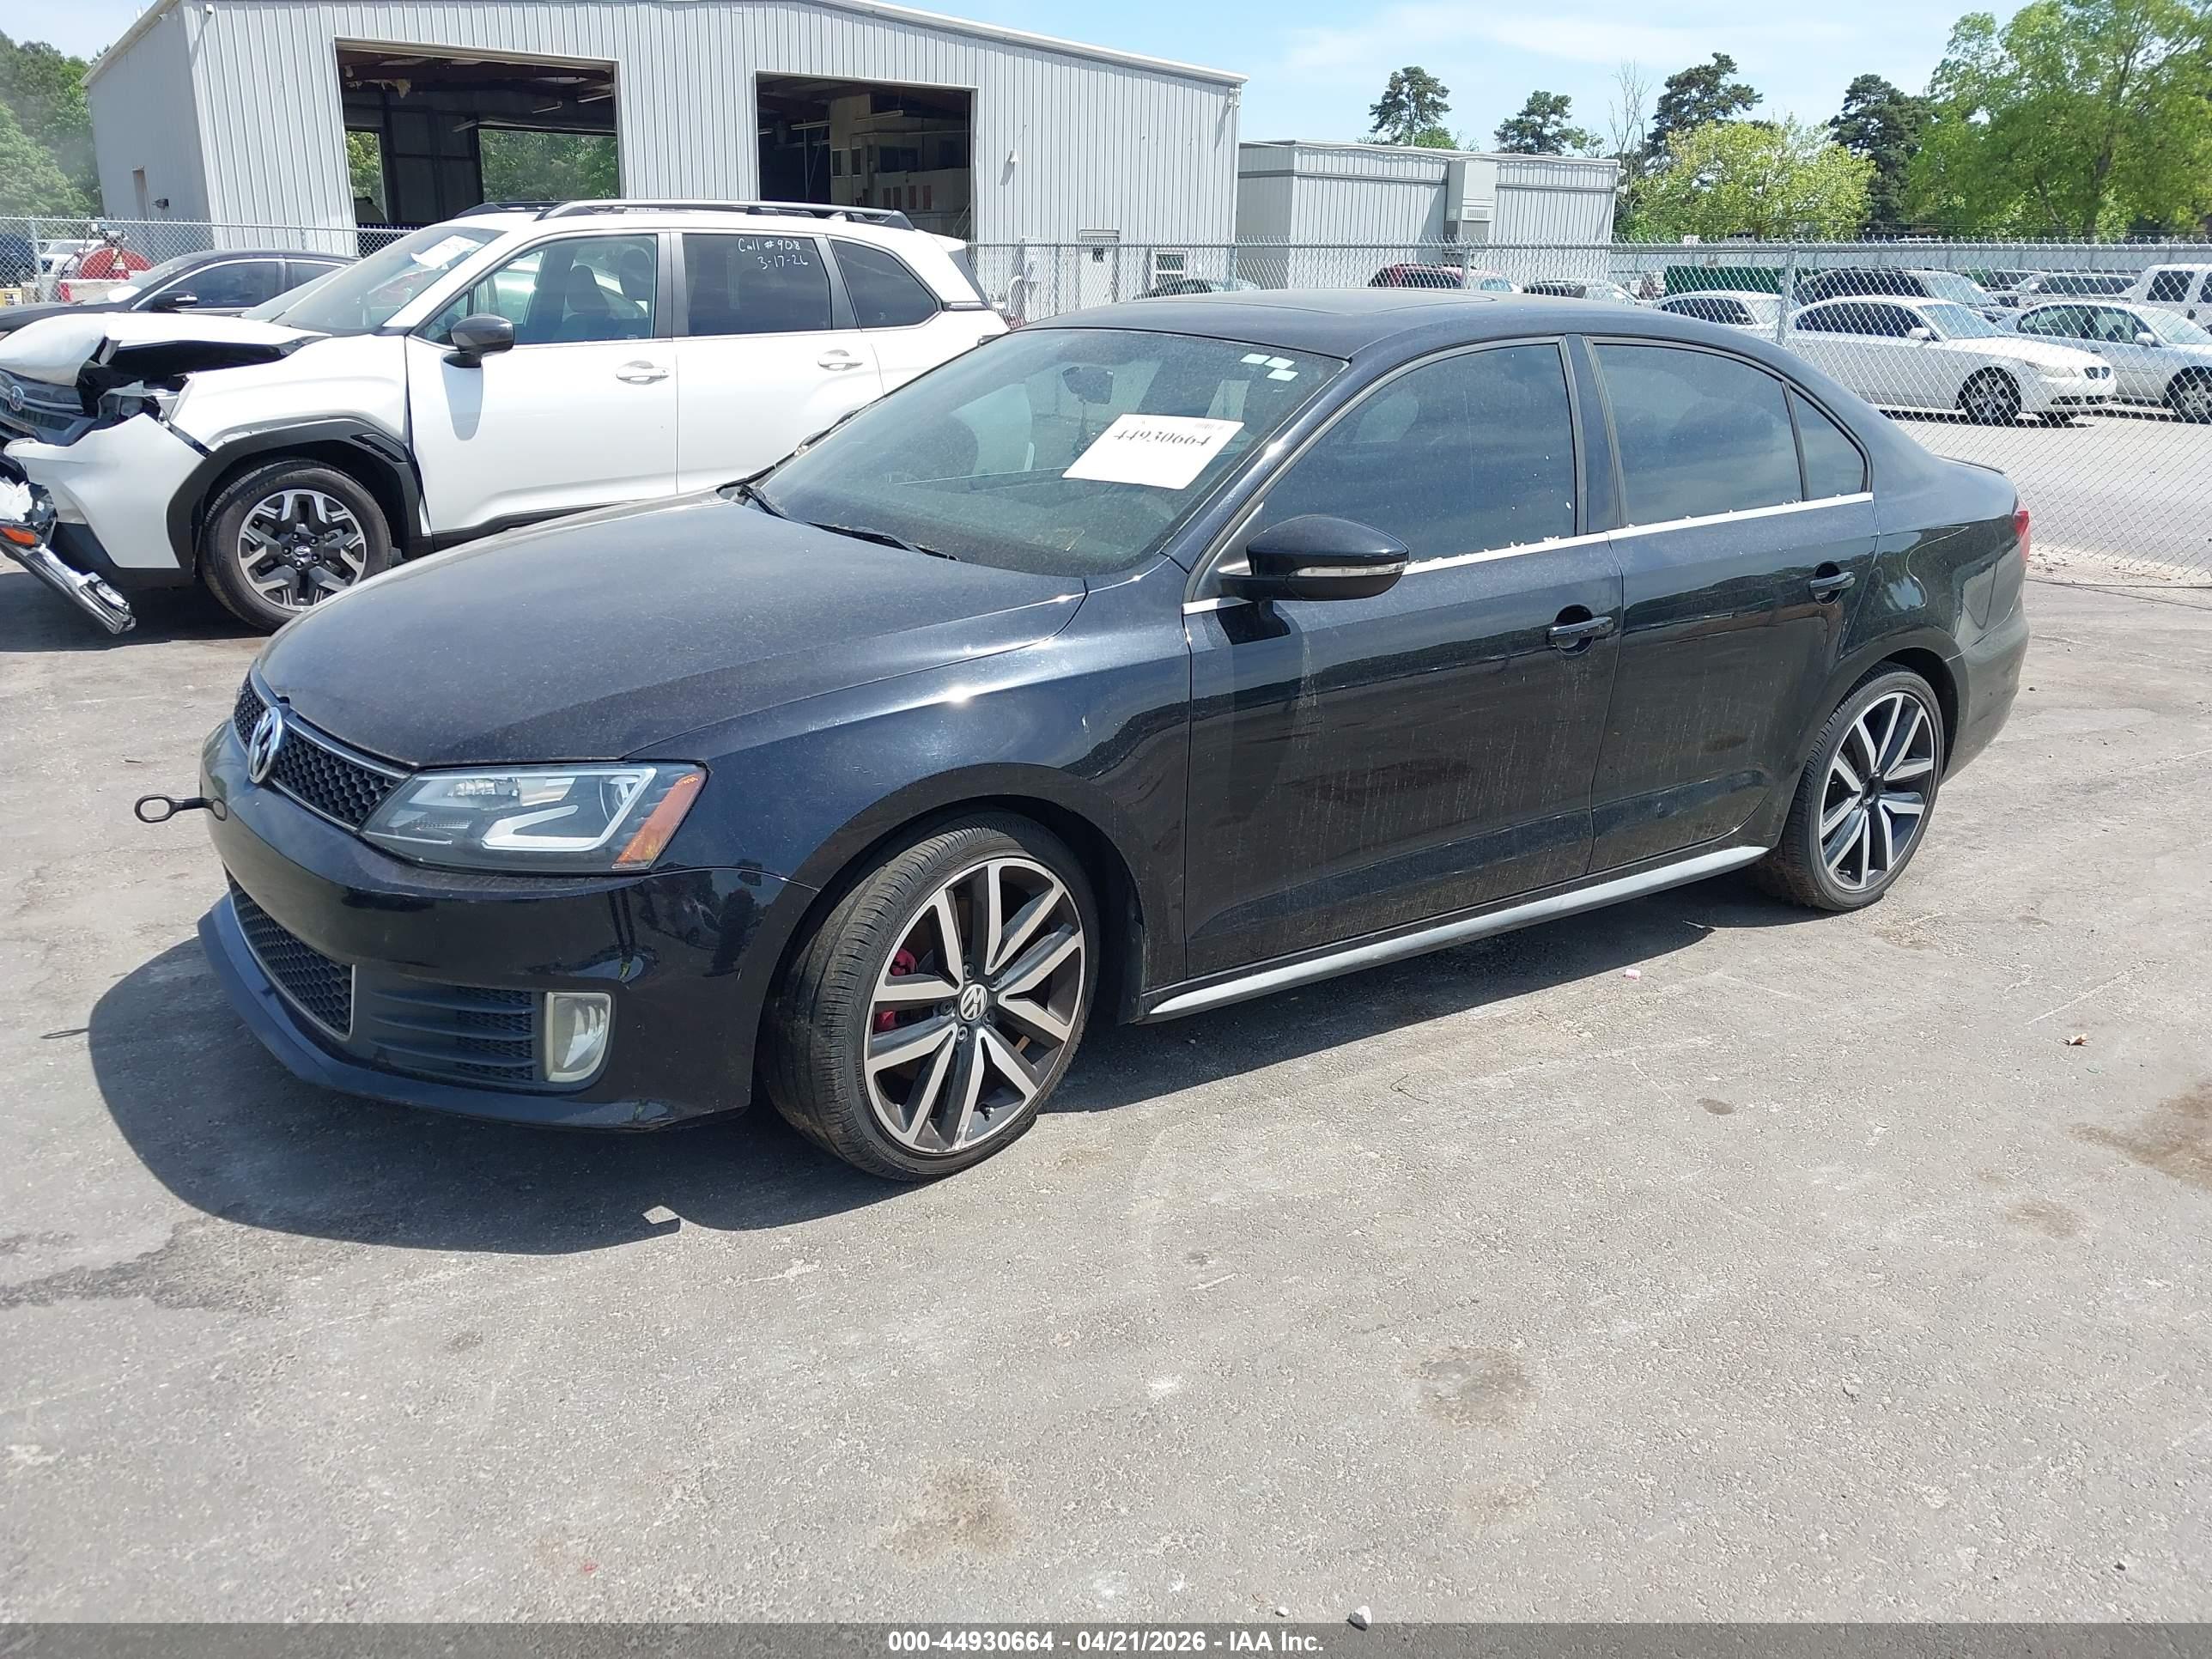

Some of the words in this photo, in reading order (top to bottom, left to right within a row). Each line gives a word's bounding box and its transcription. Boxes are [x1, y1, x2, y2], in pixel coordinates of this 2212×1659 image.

[738, 238, 760, 252] Call
[757, 254, 809, 270] 3-17-26
[1113, 429, 1212, 447] 44930664
